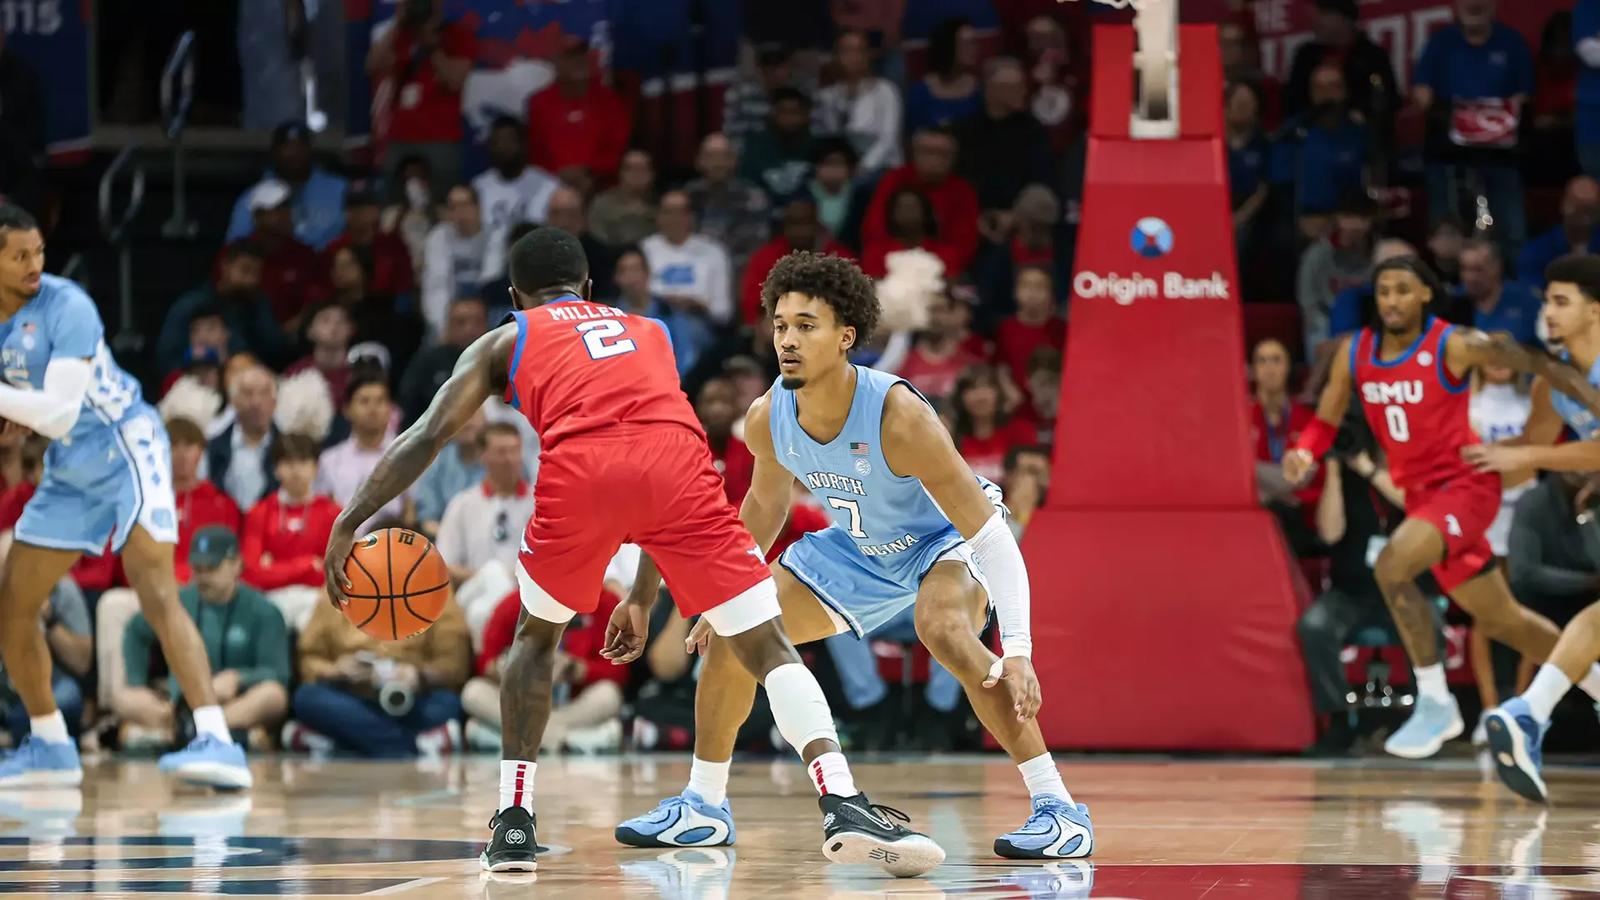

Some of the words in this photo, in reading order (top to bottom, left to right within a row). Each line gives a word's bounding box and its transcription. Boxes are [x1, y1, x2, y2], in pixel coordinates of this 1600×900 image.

[1073, 270, 1158, 306] Origin
[1163, 271, 1230, 300] Bank
[546, 304, 629, 321] MILLER
[575, 318, 638, 361] 2
[1361, 380, 1424, 405] SMU
[1384, 404, 1411, 443] 0
[806, 471, 868, 496] NORTH
[826, 495, 869, 539] 7
[859, 533, 920, 556] OLINA
